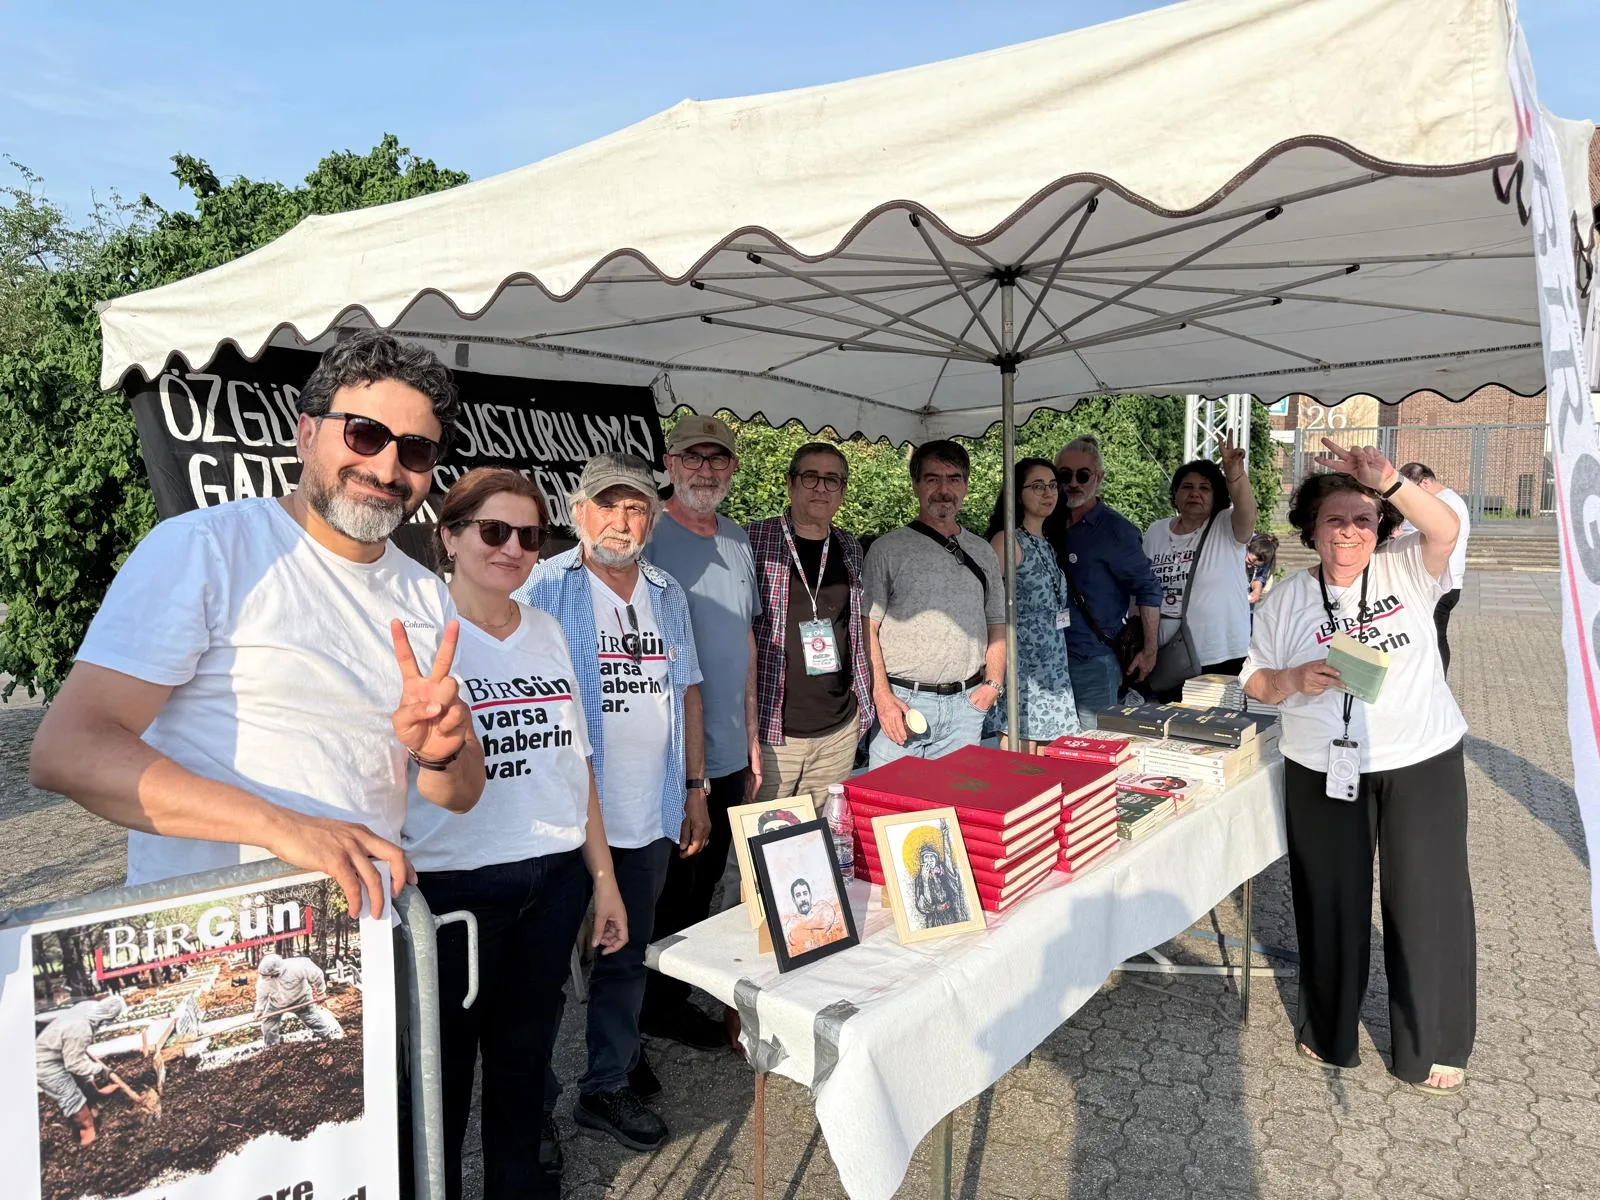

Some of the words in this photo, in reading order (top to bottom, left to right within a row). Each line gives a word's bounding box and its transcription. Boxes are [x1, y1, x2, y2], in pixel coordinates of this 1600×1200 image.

[1306, 405, 1347, 429] 26
[189, 453, 303, 509] GAZE
[600, 662, 642, 676] arsa
[602, 677, 662, 694] aberin
[602, 698, 630, 713] ar.
[478, 706, 548, 731] varsa
[482, 725, 572, 757] haberin
[485, 760, 532, 780] var.
